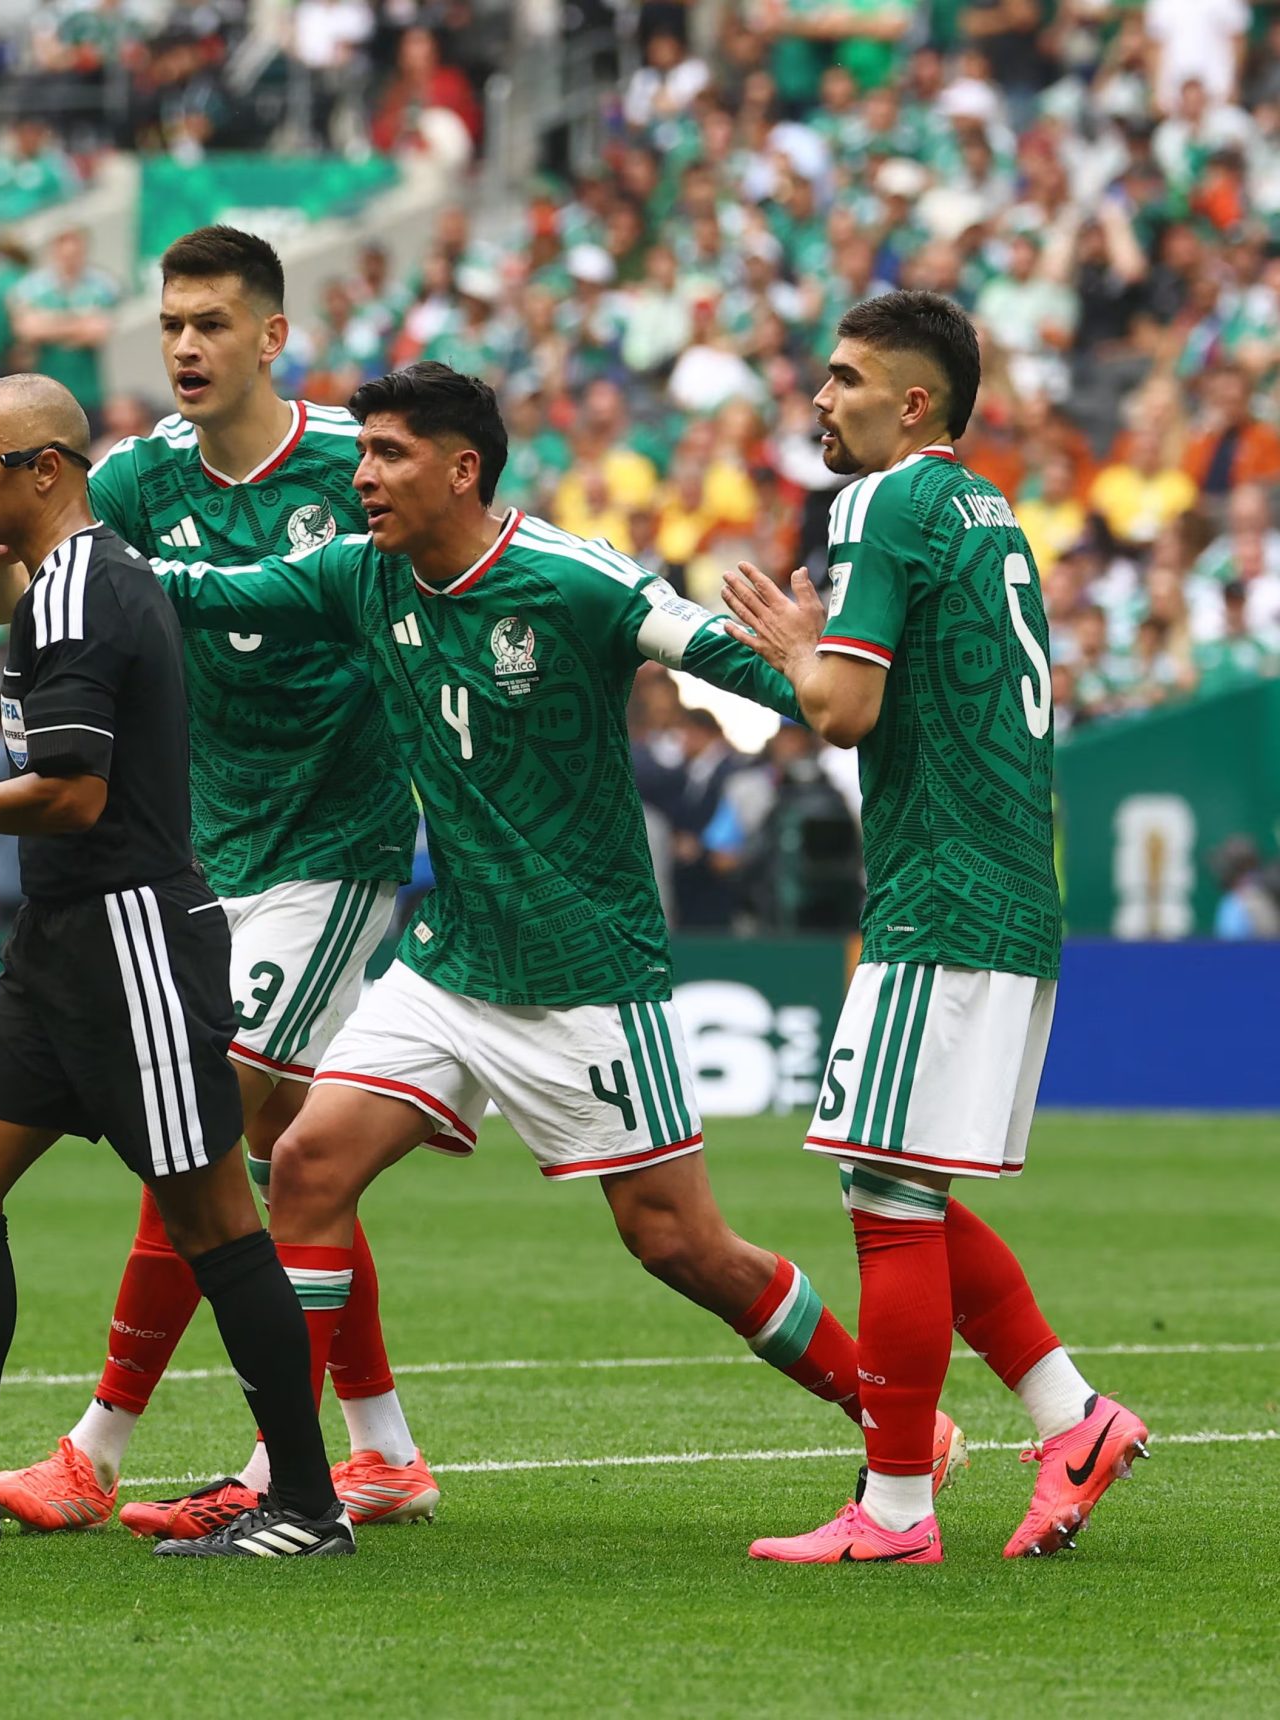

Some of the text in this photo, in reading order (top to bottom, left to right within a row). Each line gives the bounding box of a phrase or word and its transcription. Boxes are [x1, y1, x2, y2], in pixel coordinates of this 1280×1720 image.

[496, 661, 535, 674] MÉXICO
[1004, 553, 1051, 739] 5
[441, 684, 473, 760] 4
[234, 960, 285, 1030] 3
[670, 979, 775, 1117] 6
[819, 1048, 855, 1121] 5
[588, 1059, 637, 1132] 4
